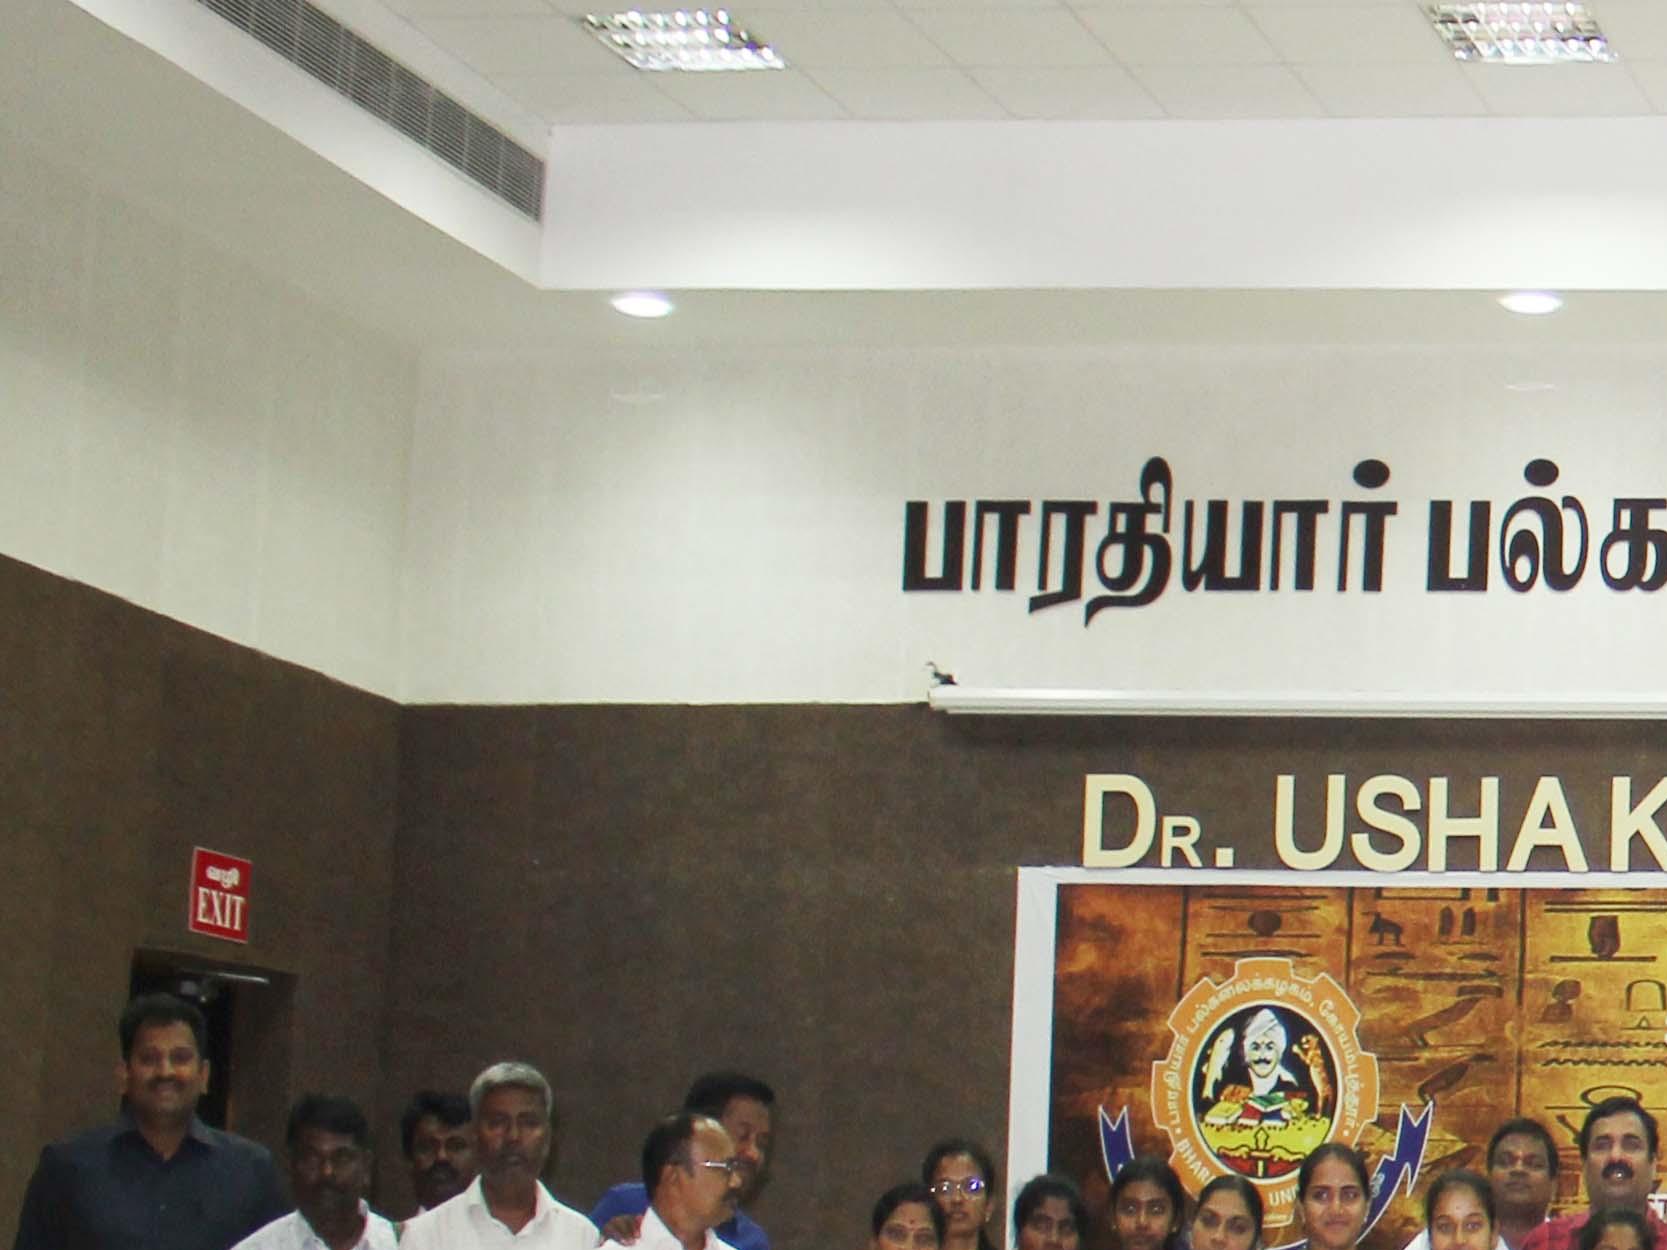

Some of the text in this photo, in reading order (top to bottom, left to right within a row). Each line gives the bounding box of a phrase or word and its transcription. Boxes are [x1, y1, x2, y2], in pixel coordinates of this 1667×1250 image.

[902, 457, 1398, 627] பாரதியார்
[1275, 774, 1589, 872] USHA
[197, 886, 246, 931] EXIT
